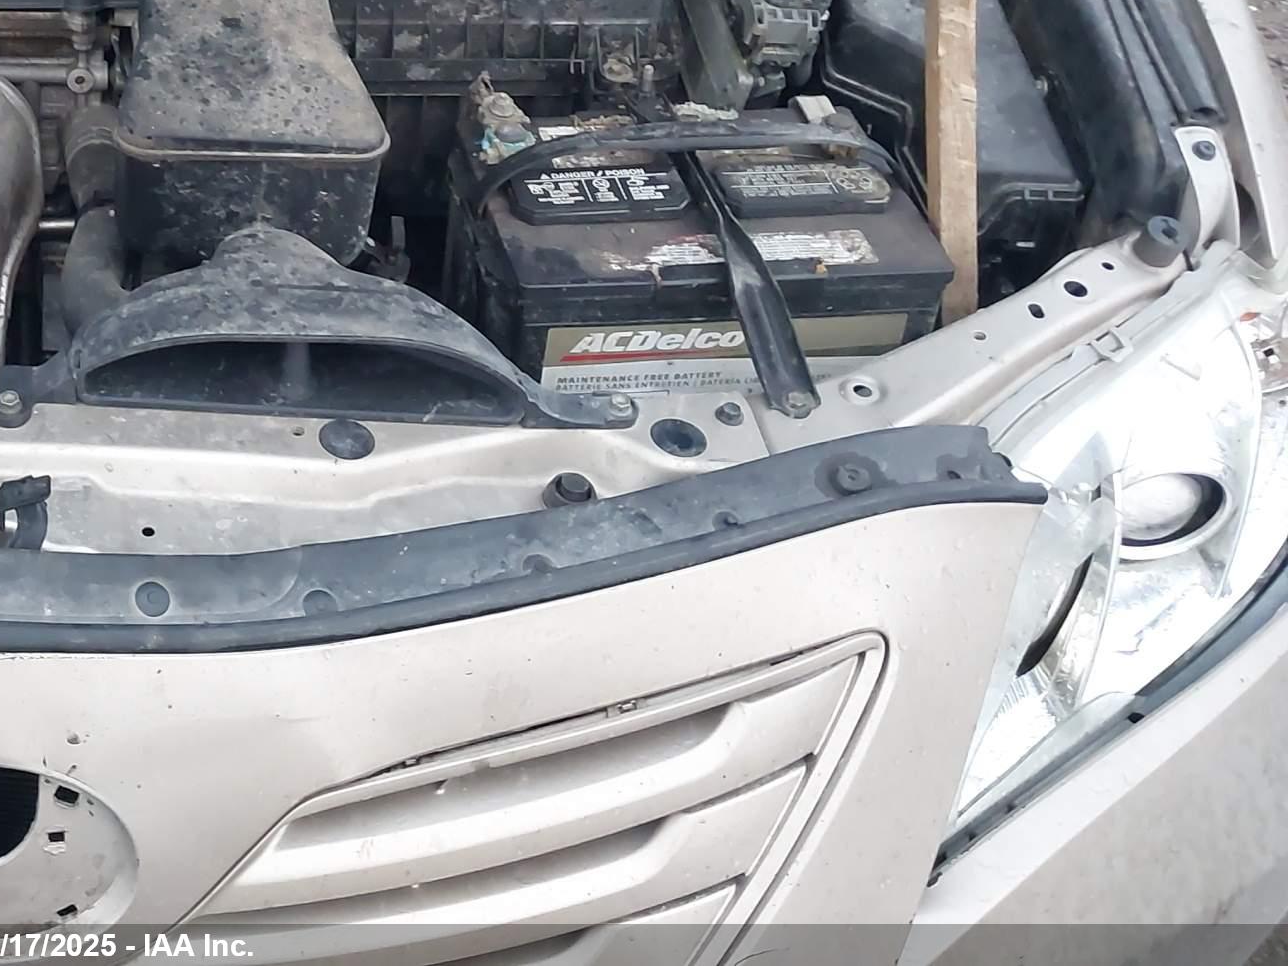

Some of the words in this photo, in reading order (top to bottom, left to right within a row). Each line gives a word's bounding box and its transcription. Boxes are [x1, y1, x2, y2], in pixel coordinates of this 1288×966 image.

[551, 170, 595, 180] DANGER
[605, 168, 645, 177] POISON
[569, 328, 745, 354] ACDelco
[556, 373, 640, 384] MAINTENANCE
[643, 372, 670, 381] FREE
[674, 371, 722, 381] BATTERY
[605, 381, 632, 390] SANS
